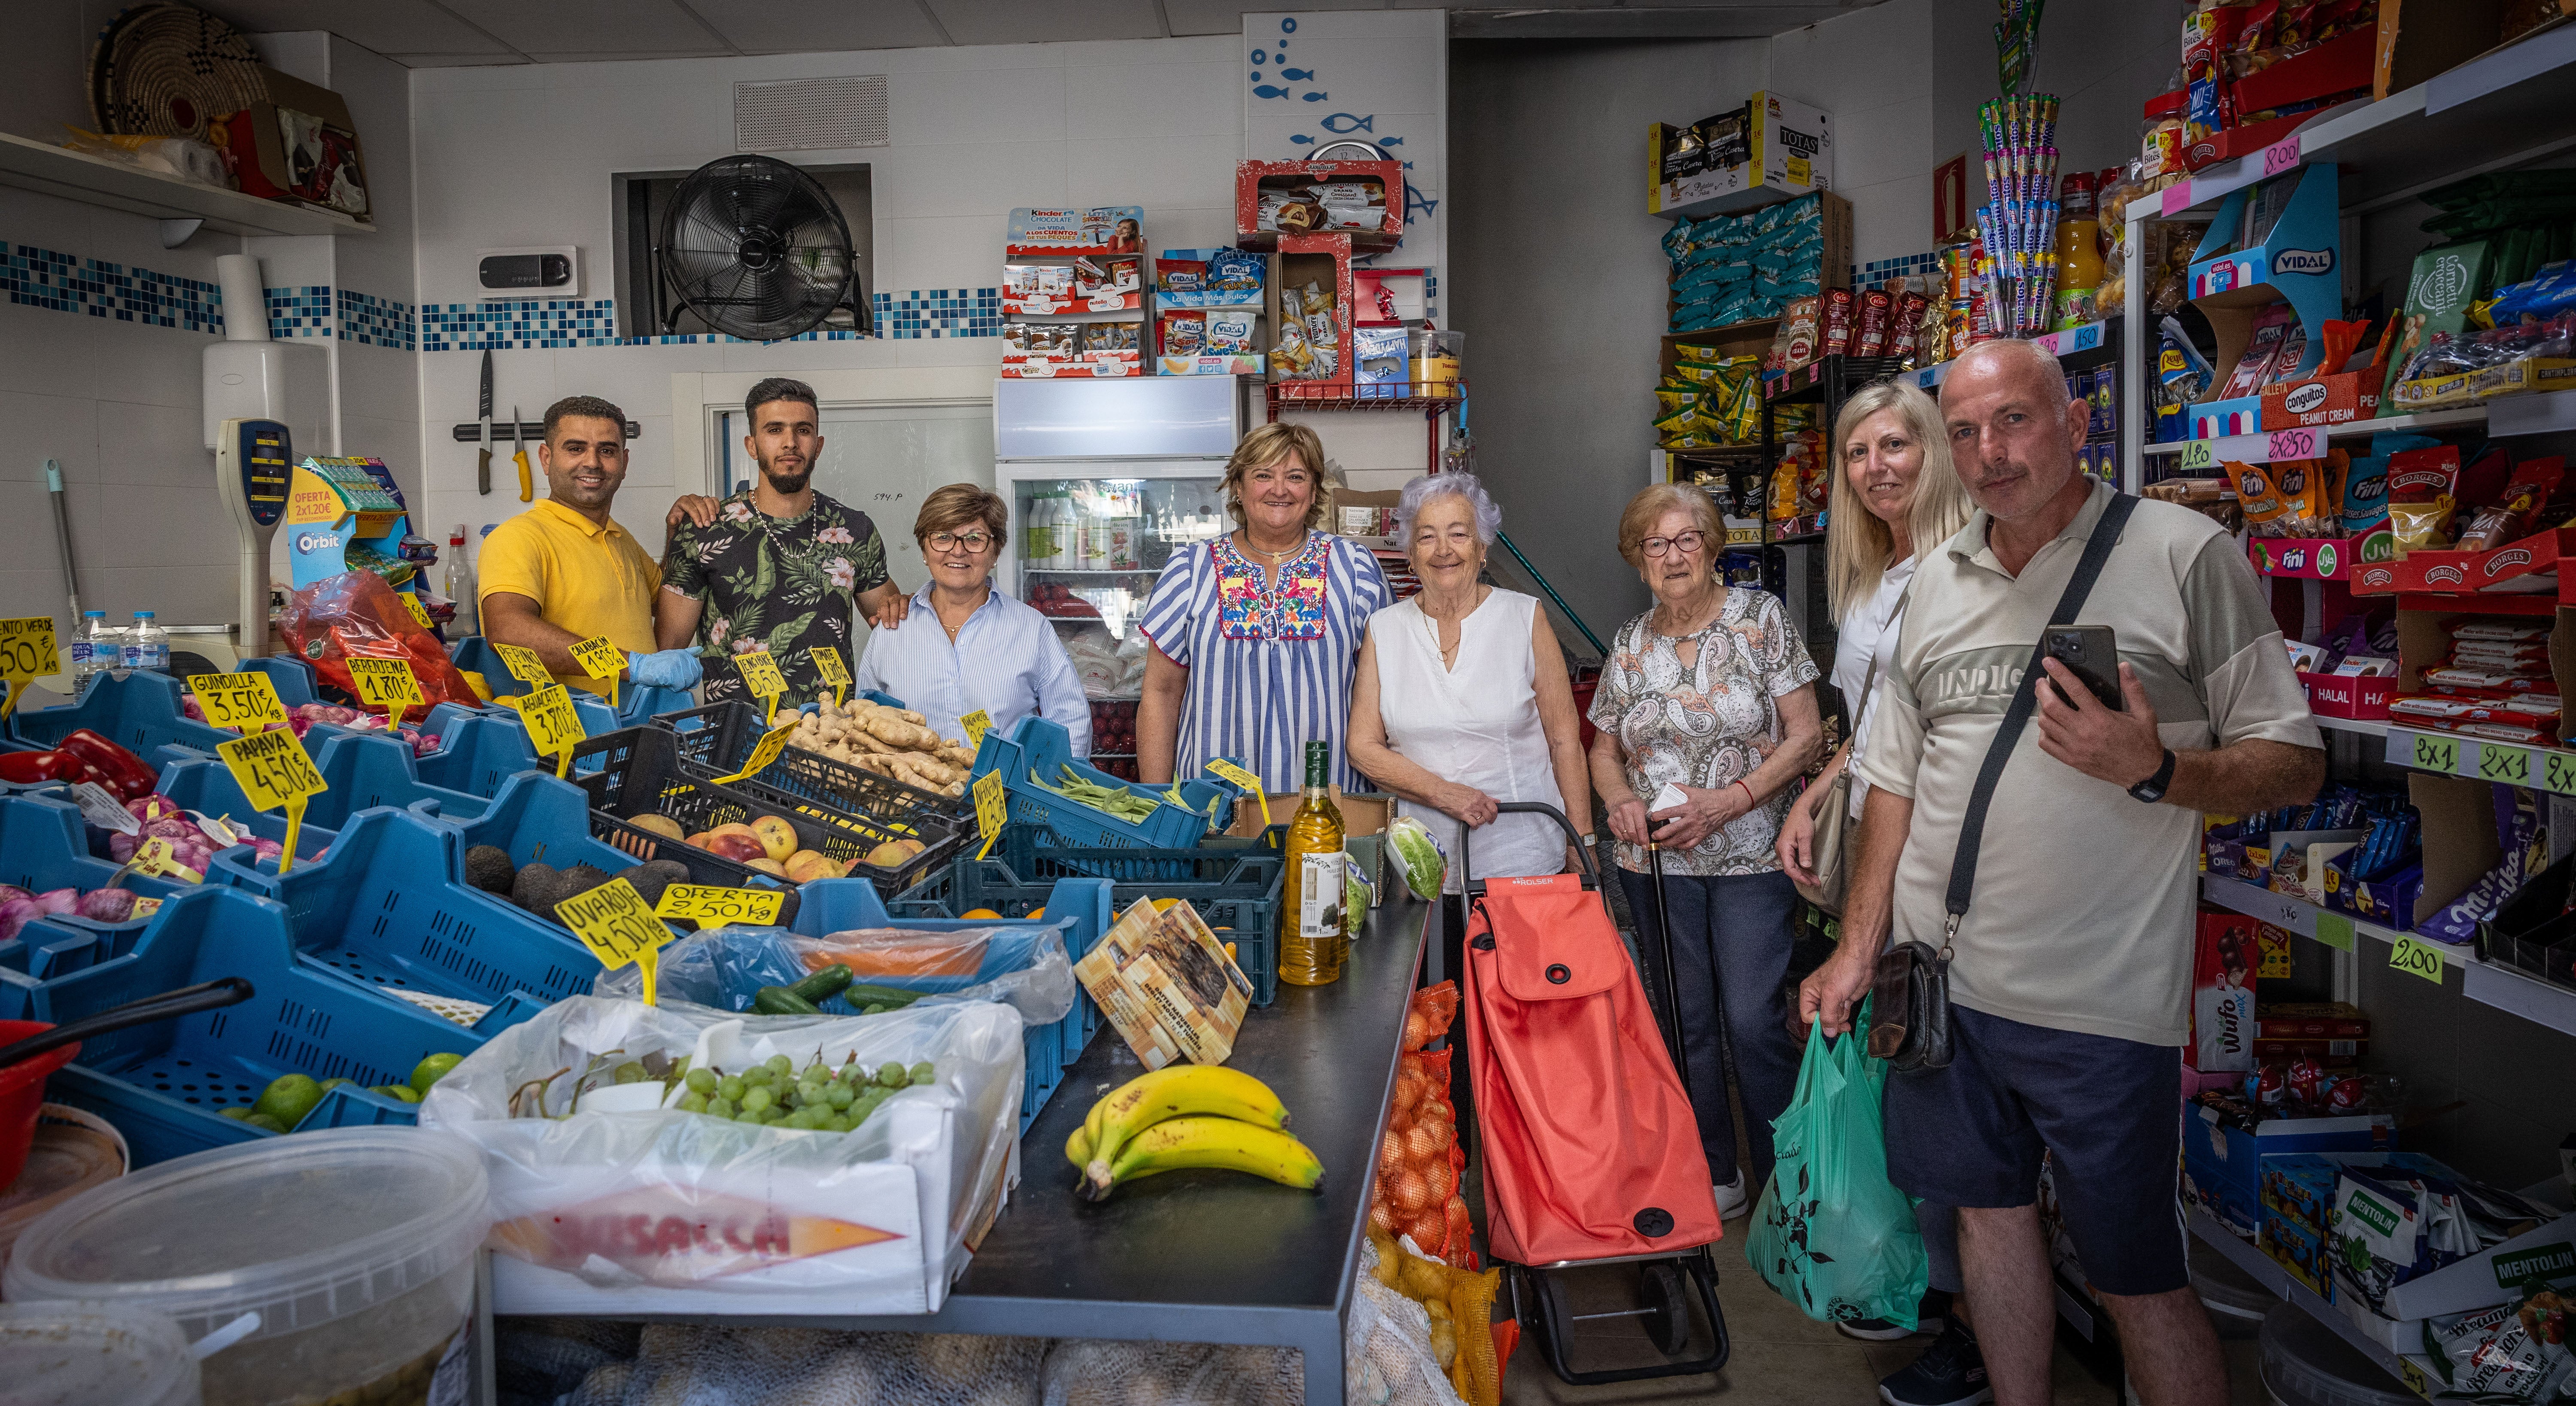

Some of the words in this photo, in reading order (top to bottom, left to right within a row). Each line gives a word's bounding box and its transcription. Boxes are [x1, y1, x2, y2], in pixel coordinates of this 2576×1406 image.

[2184, 35, 2201, 47] Bites
[2190, 51, 2207, 63] BORGES
[1782, 130, 1814, 150] TOTAS
[1725, 145, 1745, 155] Casera
[2145, 152, 2160, 164] Bites
[2194, 147, 2213, 158] BORGES
[1683, 161, 1702, 170] Casera
[1994, 205, 2005, 250] mentos
[2213, 262, 2230, 272] vidal.es
[2281, 256, 2327, 269] VIDAL
[2435, 258, 2445, 317] croccanti
[2035, 281, 2046, 325] mentos
[2261, 383, 2287, 396] GALLETA
[2287, 386, 2325, 408] conguitos
[2300, 411, 2327, 425] PEANUT
[2329, 408, 2354, 422] CREAM
[2241, 473, 2263, 493] Fini
[2284, 469, 2304, 492] Fini
[2400, 473, 2439, 484] BORGES
[295, 491, 330, 503] OFERTA
[296, 503, 331, 516] 2x1.20€
[301, 535, 339, 551] Orbit
[2283, 550, 2305, 568] Fini
[2490, 553, 2524, 571] BORGES
[2367, 572, 2388, 581] BORGES
[2430, 569, 2458, 579] BORGES
[26, 618, 53, 632] VERDE
[498, 645, 540, 666] PEPINO
[812, 648, 835, 661] TOMATE
[351, 659, 408, 676] BERENJENA
[2338, 663, 2362, 673] CHOCOLATE
[194, 673, 258, 691] GUINDILLA
[522, 688, 561, 713] AGUACATE
[2318, 688, 2350, 704] HALAL
[231, 732, 291, 762] PAPAYA
[2208, 842, 2226, 855] Milka
[2213, 858, 2236, 867] OREO
[671, 886, 774, 901] OFERTA
[1144, 983, 1163, 1004] DEGLET
[1161, 1004, 1177, 1021] NOUR
[1176, 1020, 1184, 1029] DE
[1182, 1029, 1202, 1051] TUNISIE
[1154, 987, 1173, 1007] DATTES
[1171, 1007, 1200, 1040] NATURELLES
[2350, 1196, 2395, 1232] MENTOLIN
[2497, 1251, 2576, 1280] MENTOLIN
